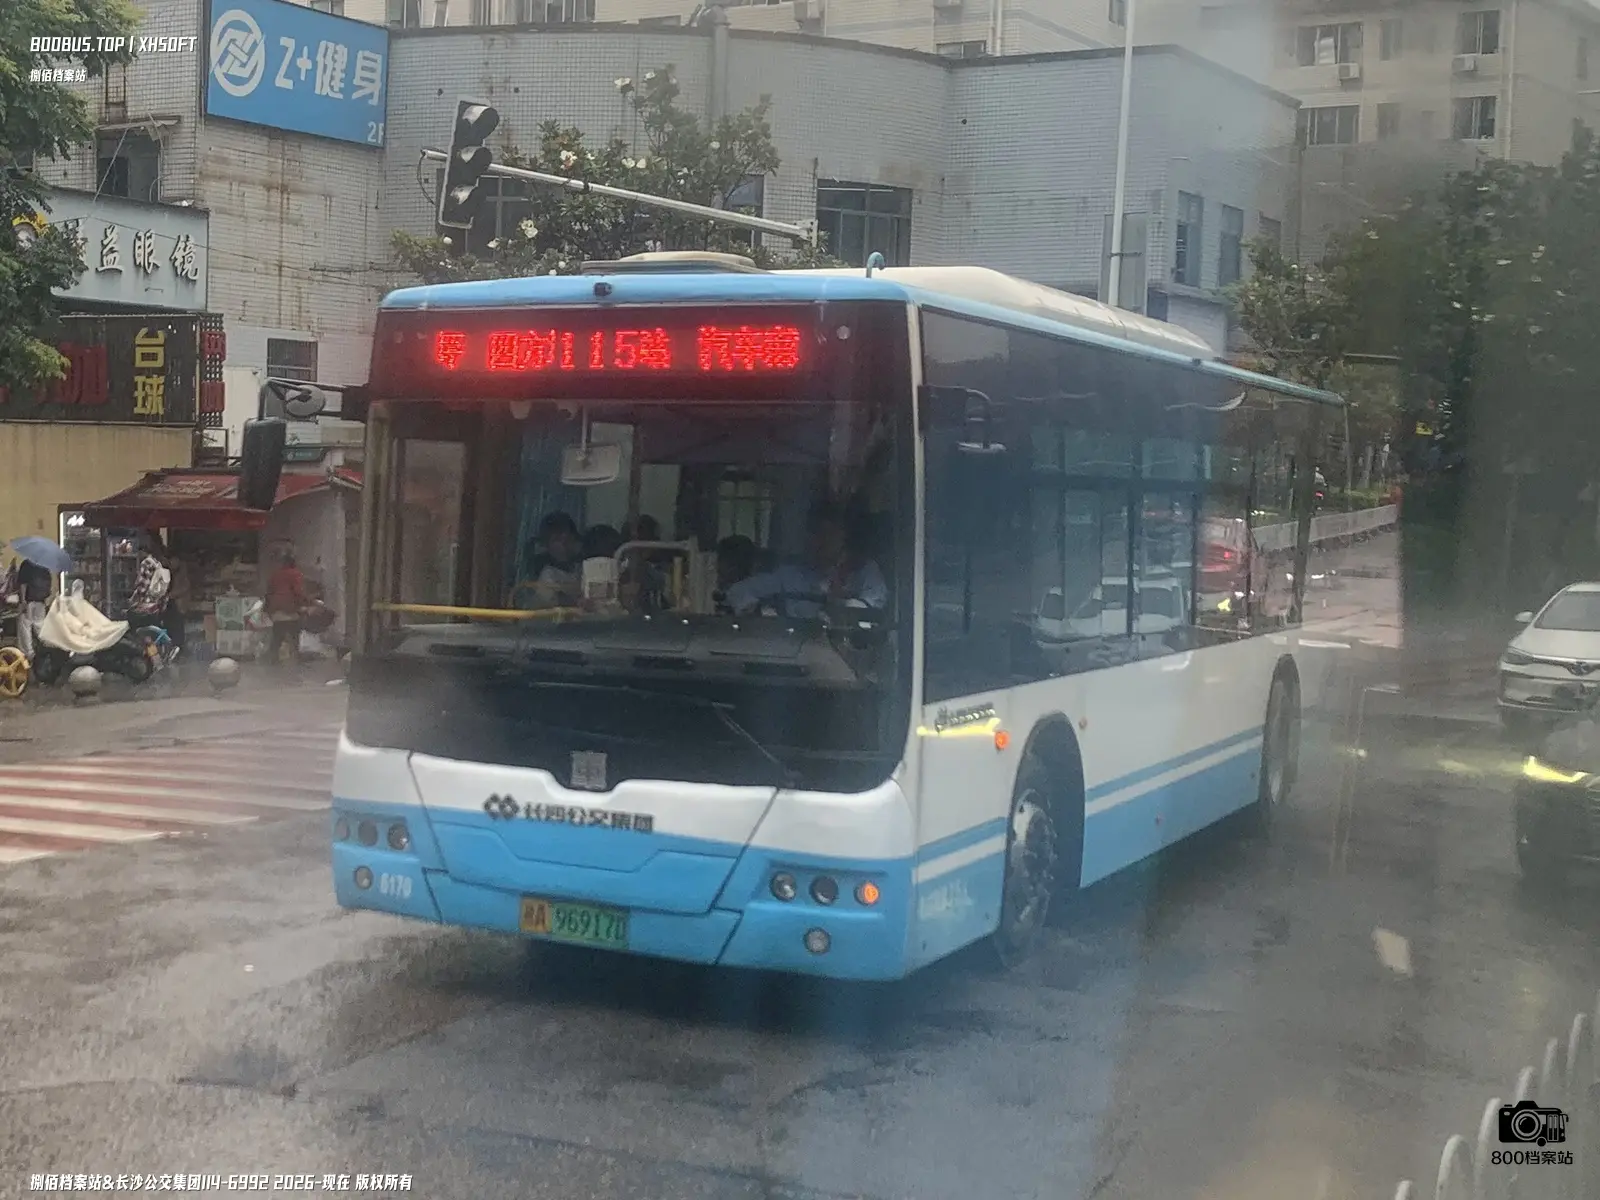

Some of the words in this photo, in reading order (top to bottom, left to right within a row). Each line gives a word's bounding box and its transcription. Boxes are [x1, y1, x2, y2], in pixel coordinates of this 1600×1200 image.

[275, 36, 383, 106] Z+健身
[63, 219, 200, 282] 益眼镜
[133, 327, 166, 416] 台球
